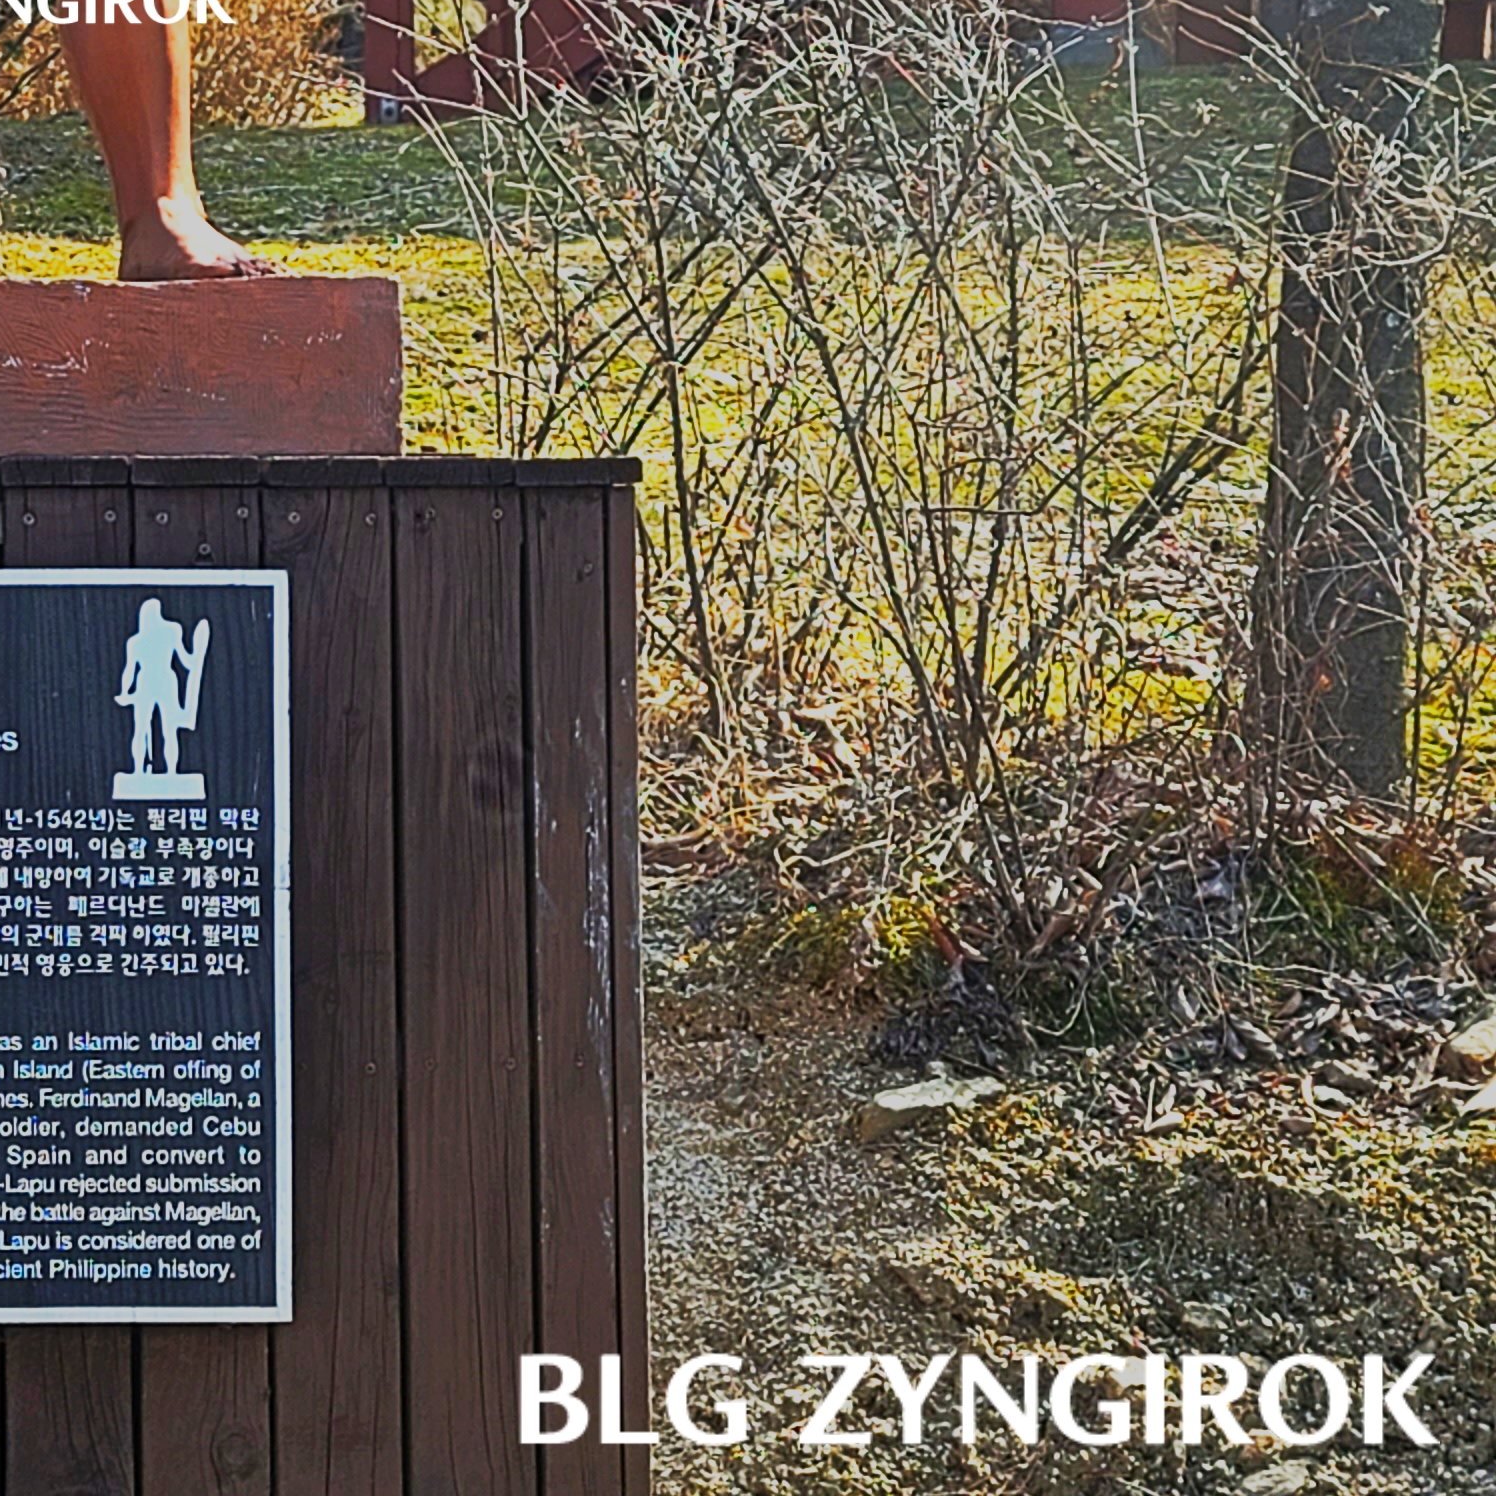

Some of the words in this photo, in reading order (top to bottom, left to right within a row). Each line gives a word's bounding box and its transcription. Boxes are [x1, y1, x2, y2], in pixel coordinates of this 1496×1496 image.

[219, 807, 260, 831] 막탄
[202, 923, 259, 947] 필리핀
[120, 953, 199, 977] 간주되고
[204, 952, 250, 976] 있다.
[31, 1035, 58, 1051] an
[68, 1031, 140, 1051] Islamic
[149, 1031, 203, 1051] tribal
[211, 1030, 261, 1051] chief
[13, 1059, 73, 1080] Island
[173, 1059, 232, 1085] offing
[239, 1059, 261, 1080] of
[39, 1087, 141, 1108] Ferdinand
[145, 1087, 243, 1113] Magellan,
[247, 1091, 261, 1108] a
[75, 1115, 193, 1137] demanded
[202, 1115, 261, 1137] Cebu
[6, 1144, 71, 1169] Spain
[85, 1144, 127, 1165] and
[141, 1145, 225, 1165] convert
[238, 1145, 261, 1165] to
[59, 1173, 141, 1198] rejected
[145, 1172, 261, 1193] submission
[30, 1201, 85, 1222] battle
[88, 1200, 162, 1227] against
[165, 1200, 261, 1227] Magellan,
[55, 1230, 73, 1251] is
[77, 1229, 191, 1251] considered
[196, 1234, 236, 1250] one
[240, 1229, 262, 1251] of
[49, 1258, 153, 1283] Philippine
[158, 1257, 236, 1283] history.
